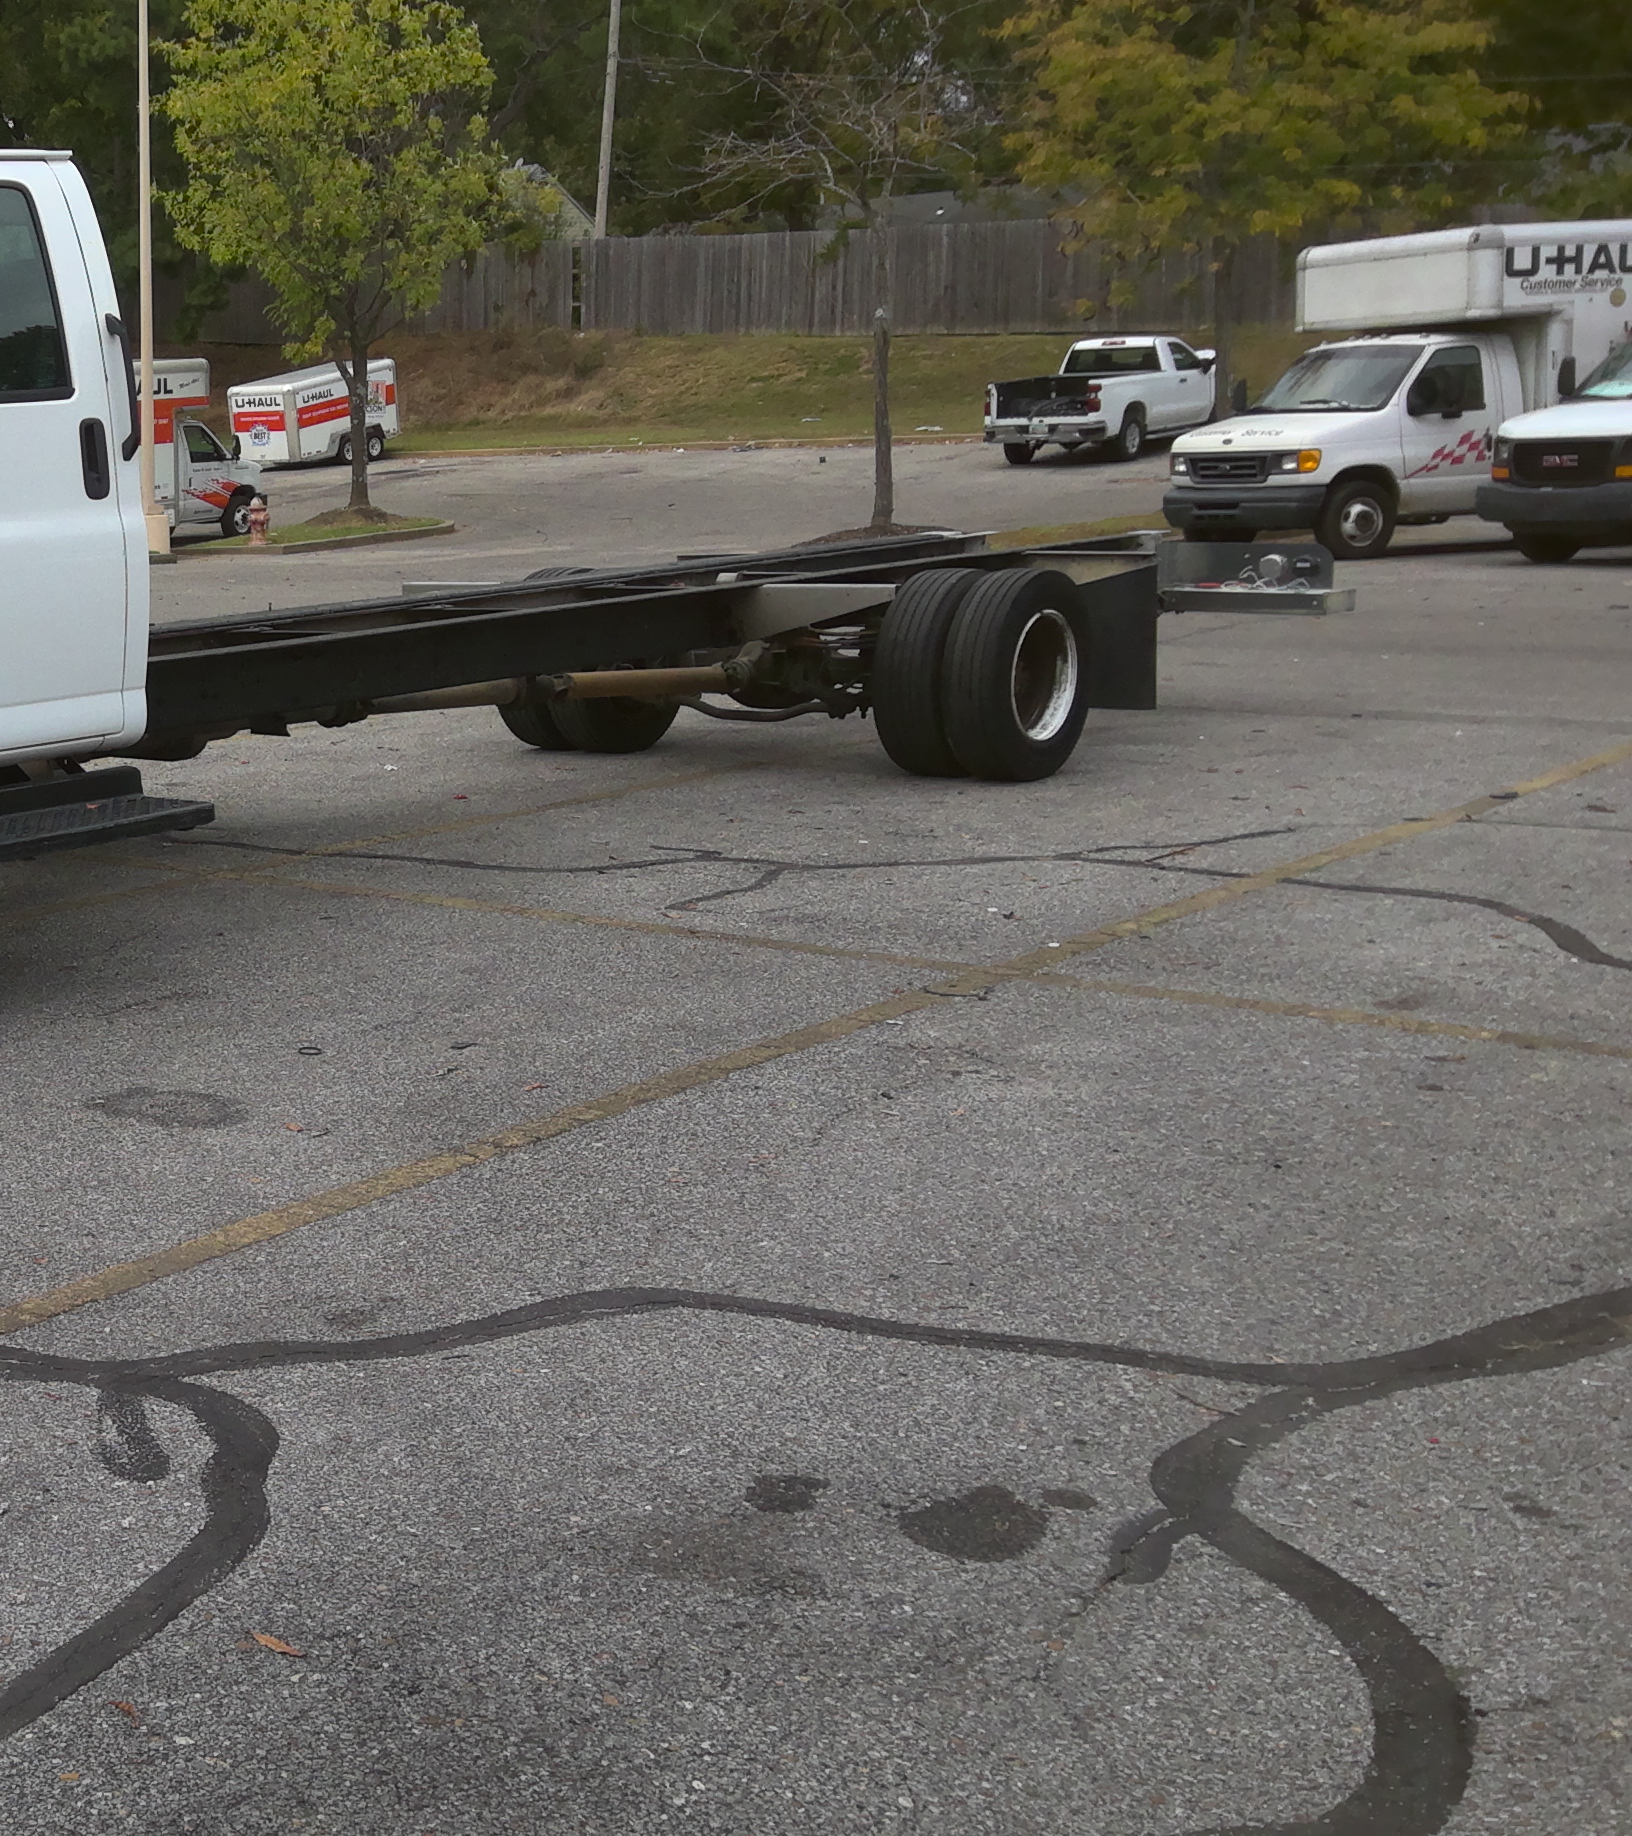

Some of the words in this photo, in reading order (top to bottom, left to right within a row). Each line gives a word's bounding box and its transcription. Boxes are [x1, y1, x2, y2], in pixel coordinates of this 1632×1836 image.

[1520, 277, 1577, 291] Customer
[1579, 275, 1623, 288] Service
[234, 396, 281, 409] U-HAUL
[302, 388, 334, 404] U-HAUL
